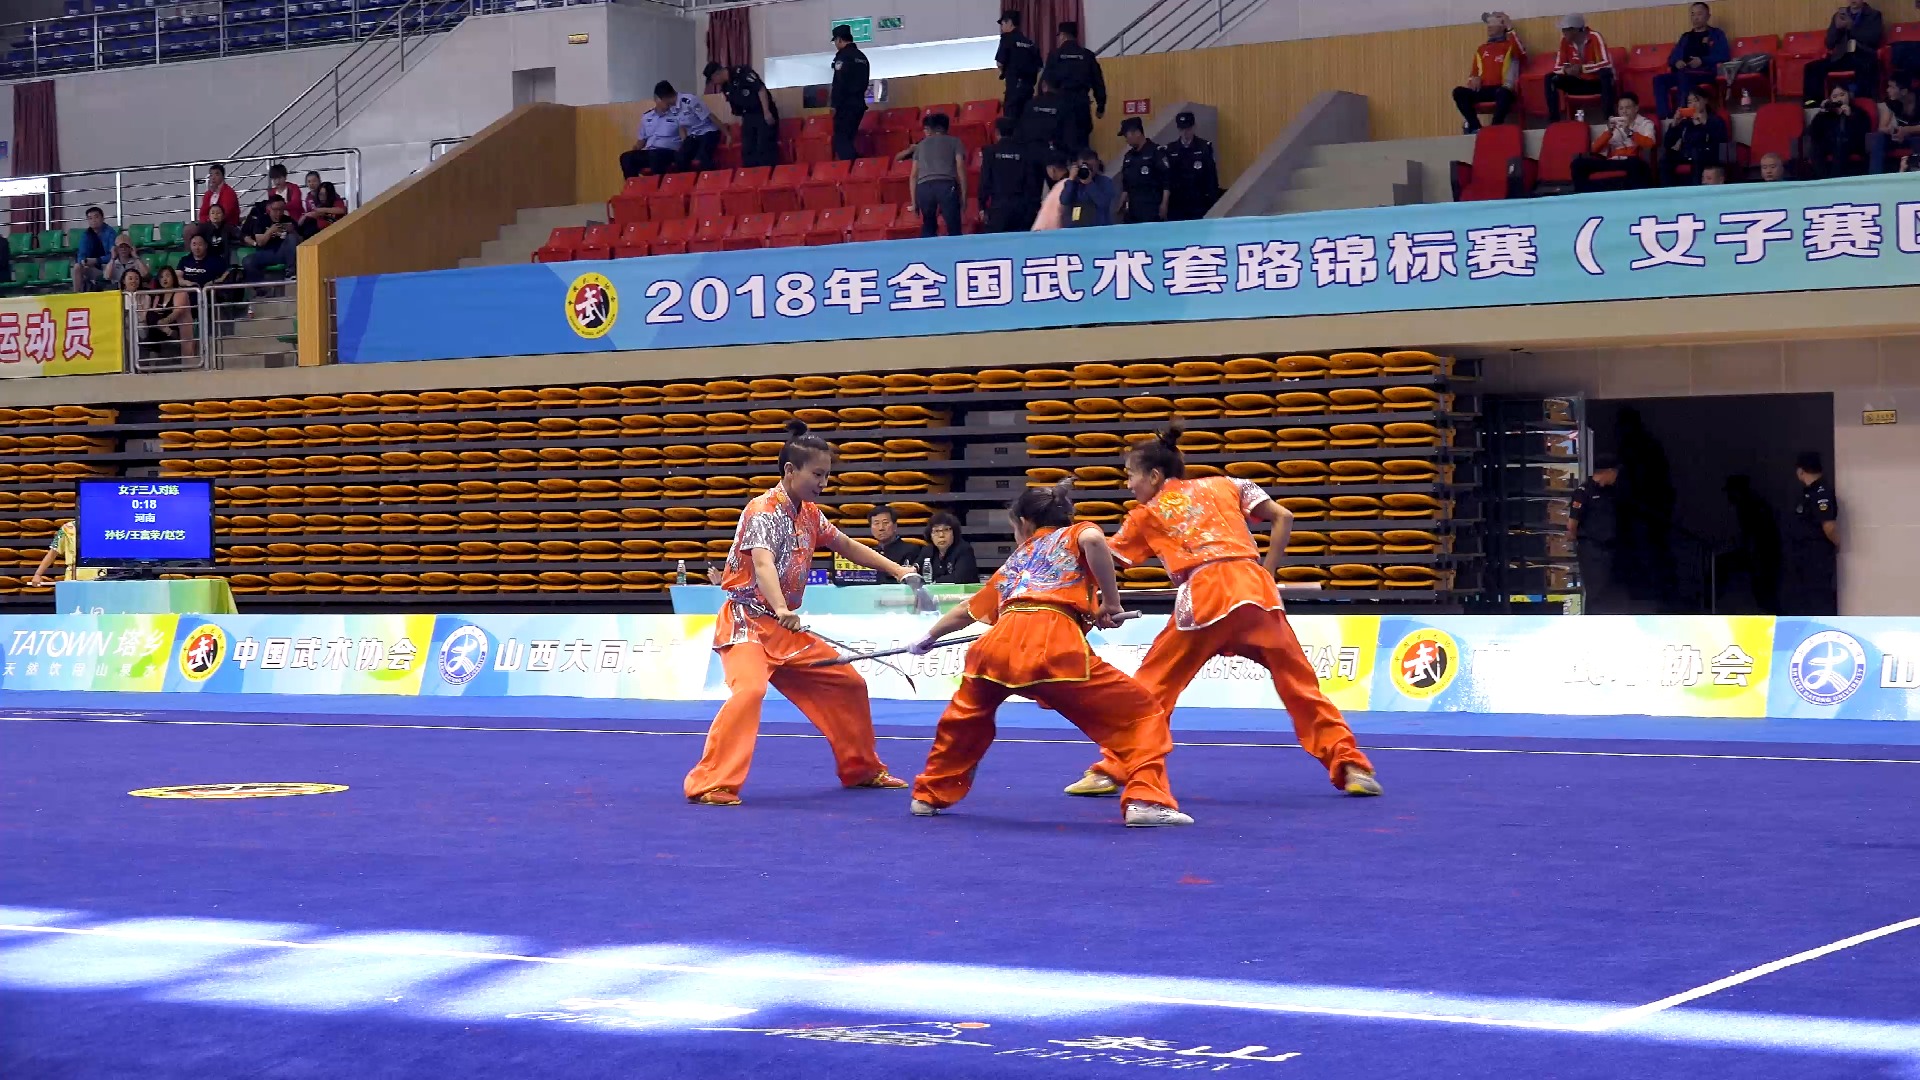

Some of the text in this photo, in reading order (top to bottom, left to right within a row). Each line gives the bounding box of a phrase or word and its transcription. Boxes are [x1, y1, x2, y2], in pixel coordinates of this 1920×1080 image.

[118, 484, 180, 496] 女子三人对练
[131, 499, 157, 509] 0:18
[134, 513, 156, 523] 河南
[7, 627, 165, 658] TATOWN 塔乡
[232, 636, 417, 671] 中国武术协会
[494, 638, 682, 673] 山西大同大
